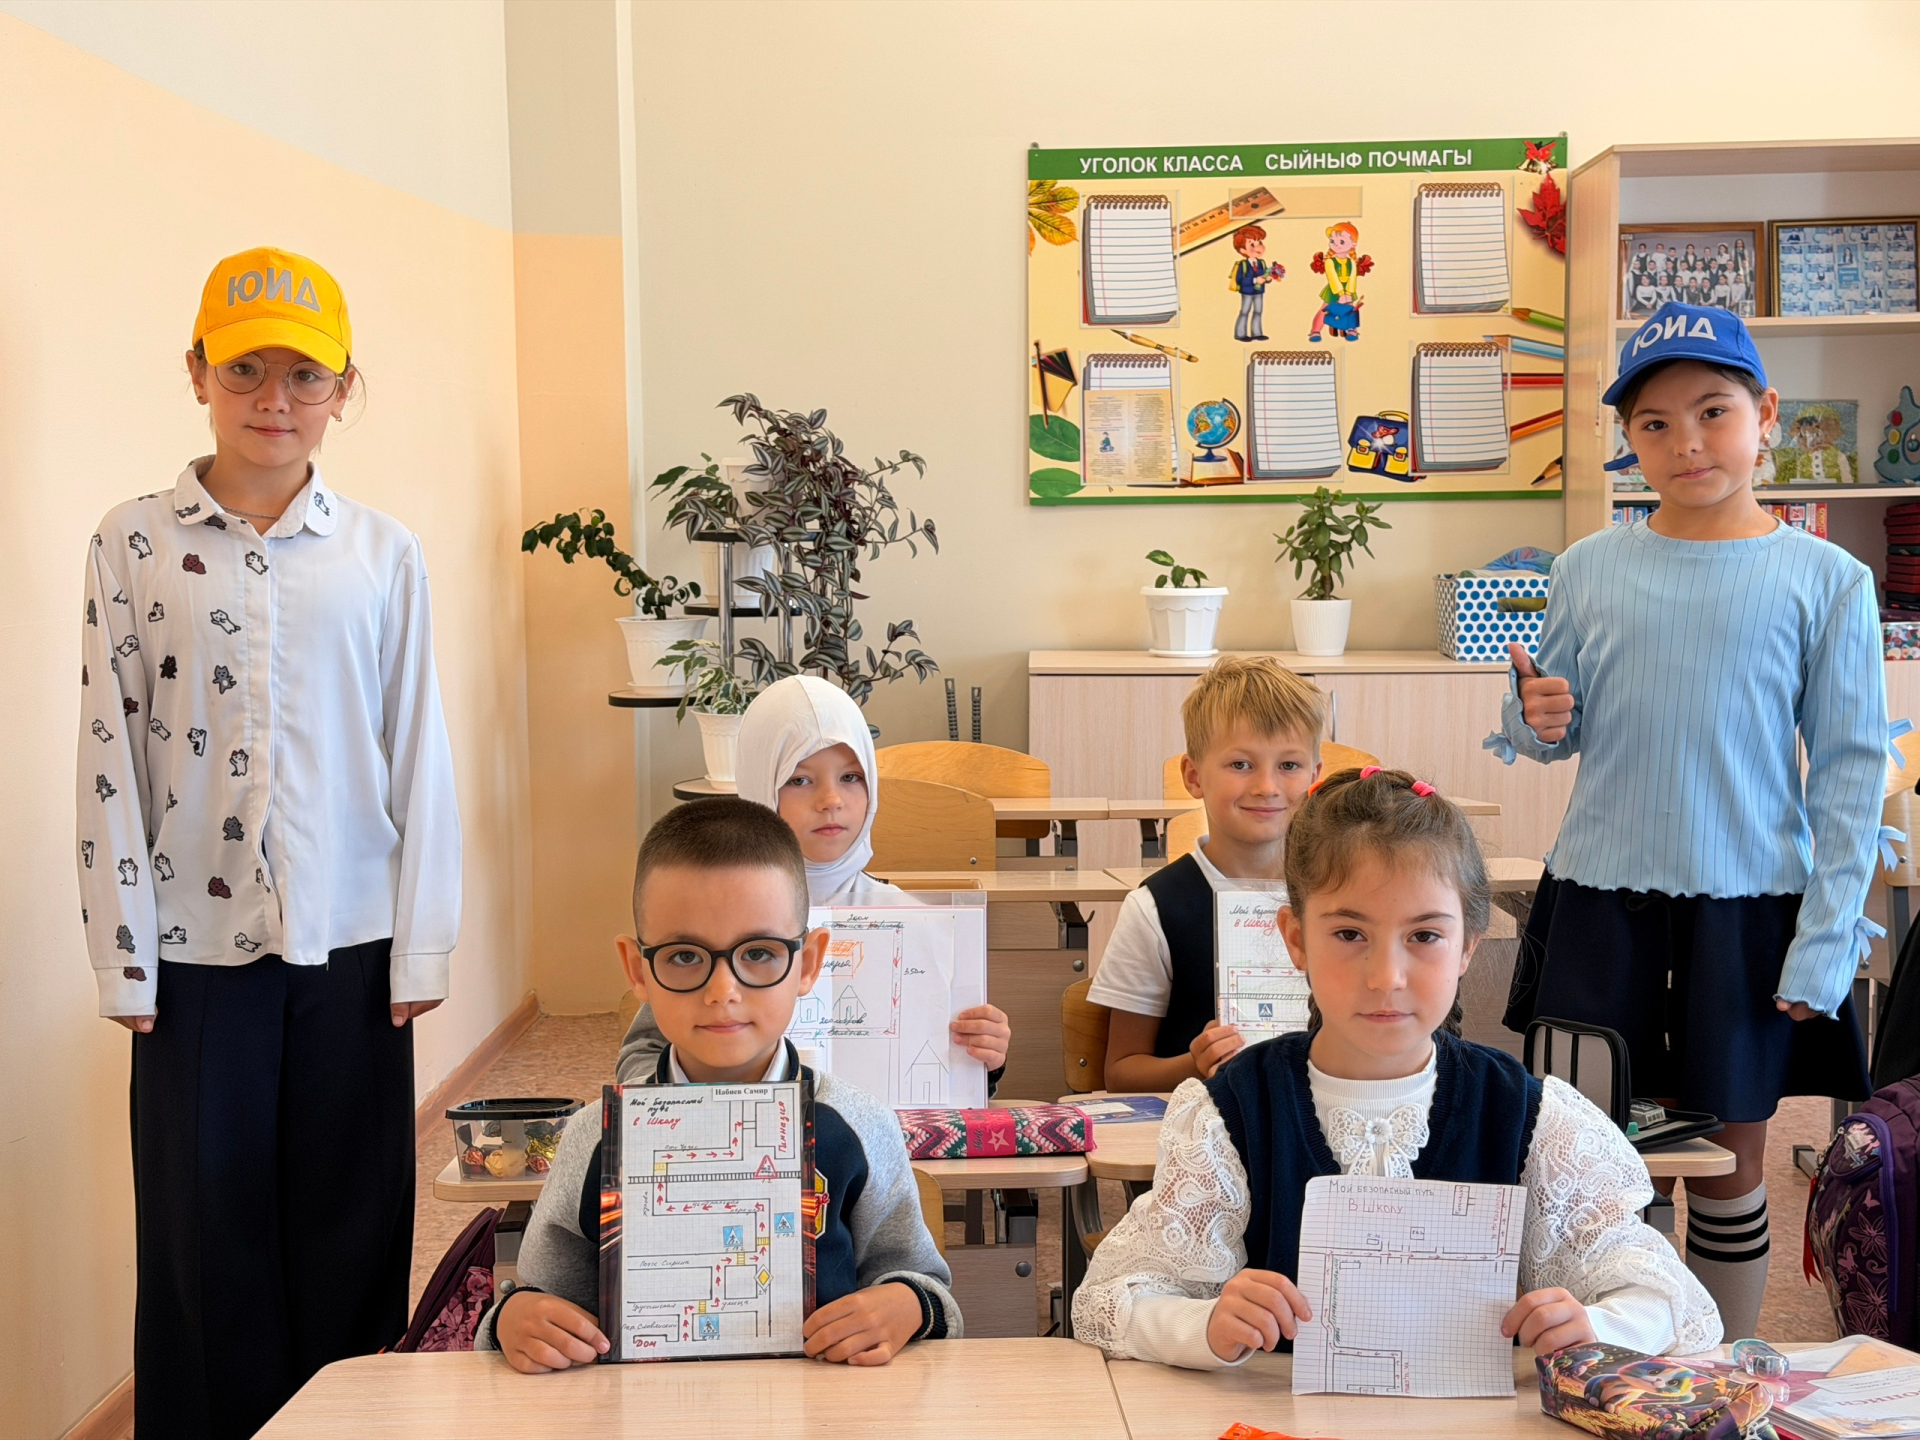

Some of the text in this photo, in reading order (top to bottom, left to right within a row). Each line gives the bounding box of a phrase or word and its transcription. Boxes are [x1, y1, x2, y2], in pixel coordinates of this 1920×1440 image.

[1079, 149, 1473, 174] УГОЛОК КЛАССА СЫЙНЫФ ПОЧМАГЫ
[227, 267, 321, 313] ЮИД
[1632, 314, 1717, 358] ЮИД
[630, 1097, 648, 1106] Мой
